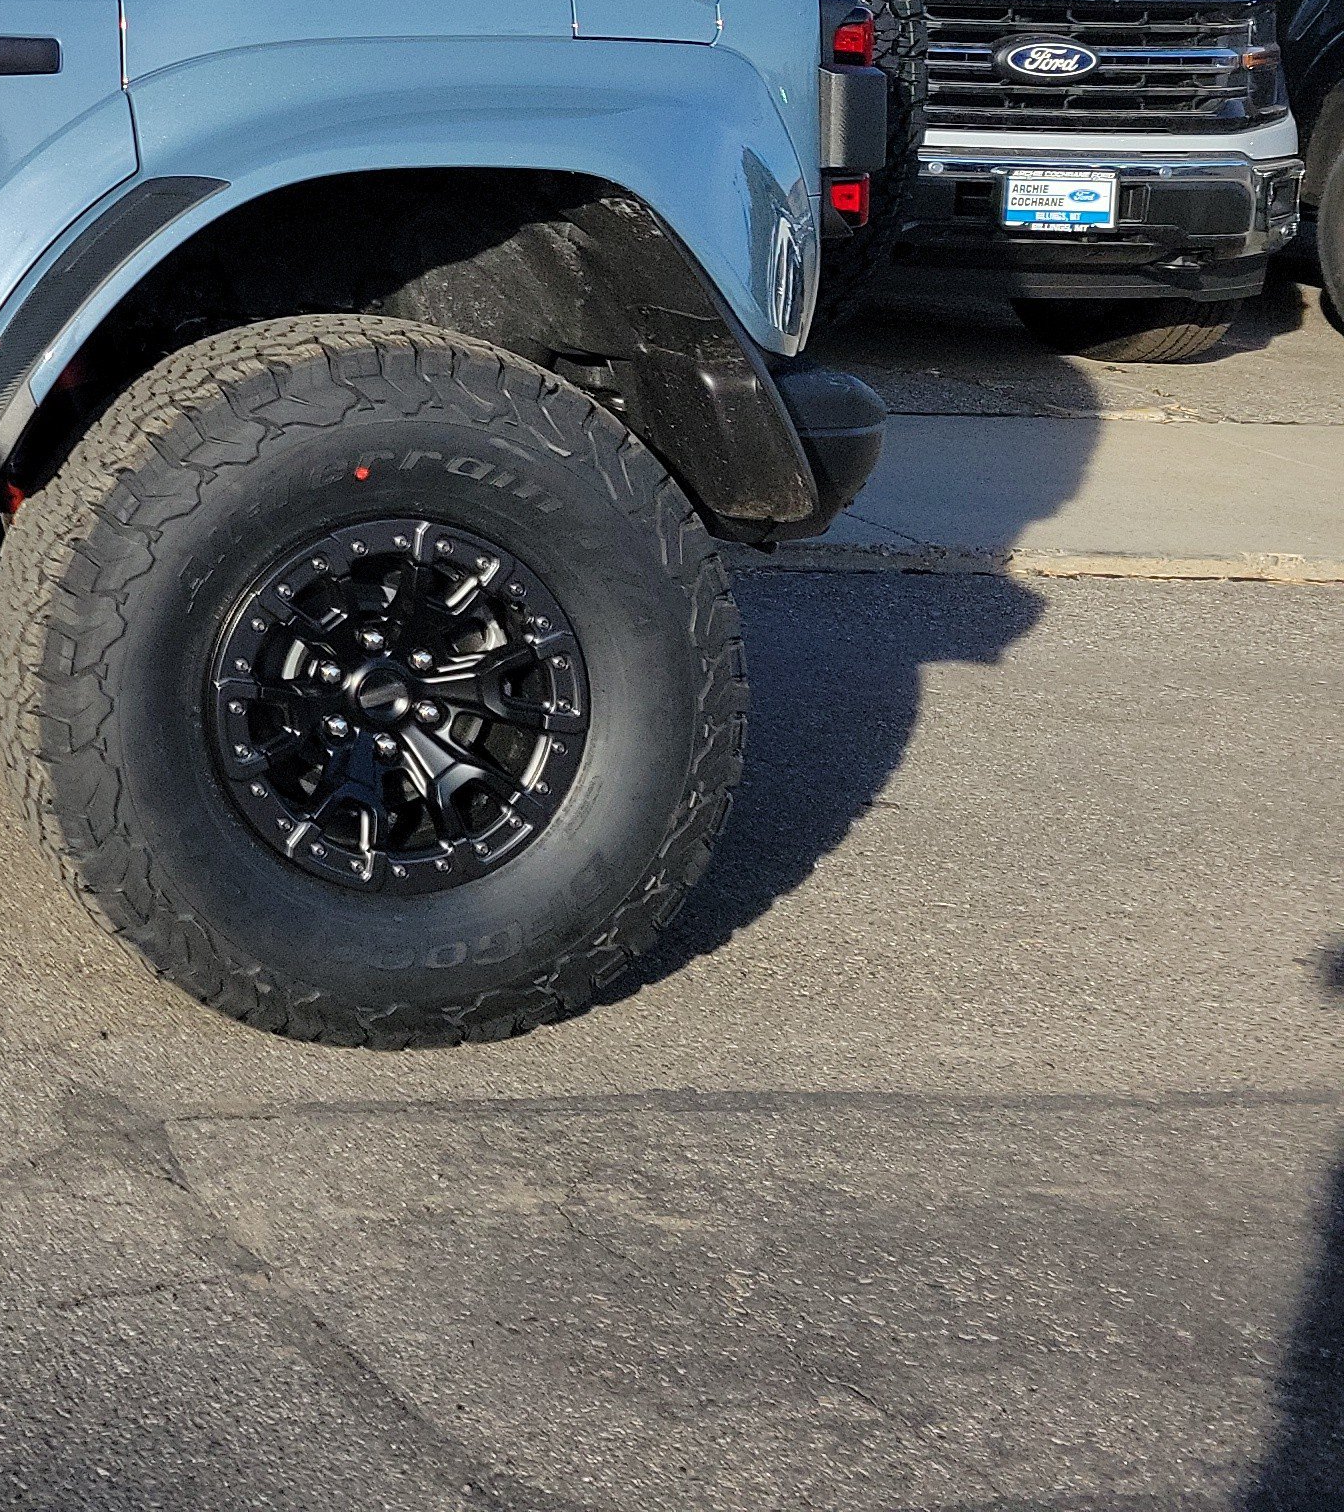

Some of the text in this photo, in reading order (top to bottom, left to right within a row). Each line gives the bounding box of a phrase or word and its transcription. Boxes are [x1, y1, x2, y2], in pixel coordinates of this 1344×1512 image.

[1024, 48, 1081, 71] Ford
[1012, 184, 1050, 194] ARCHIE
[1010, 196, 1065, 207] COCHRANE
